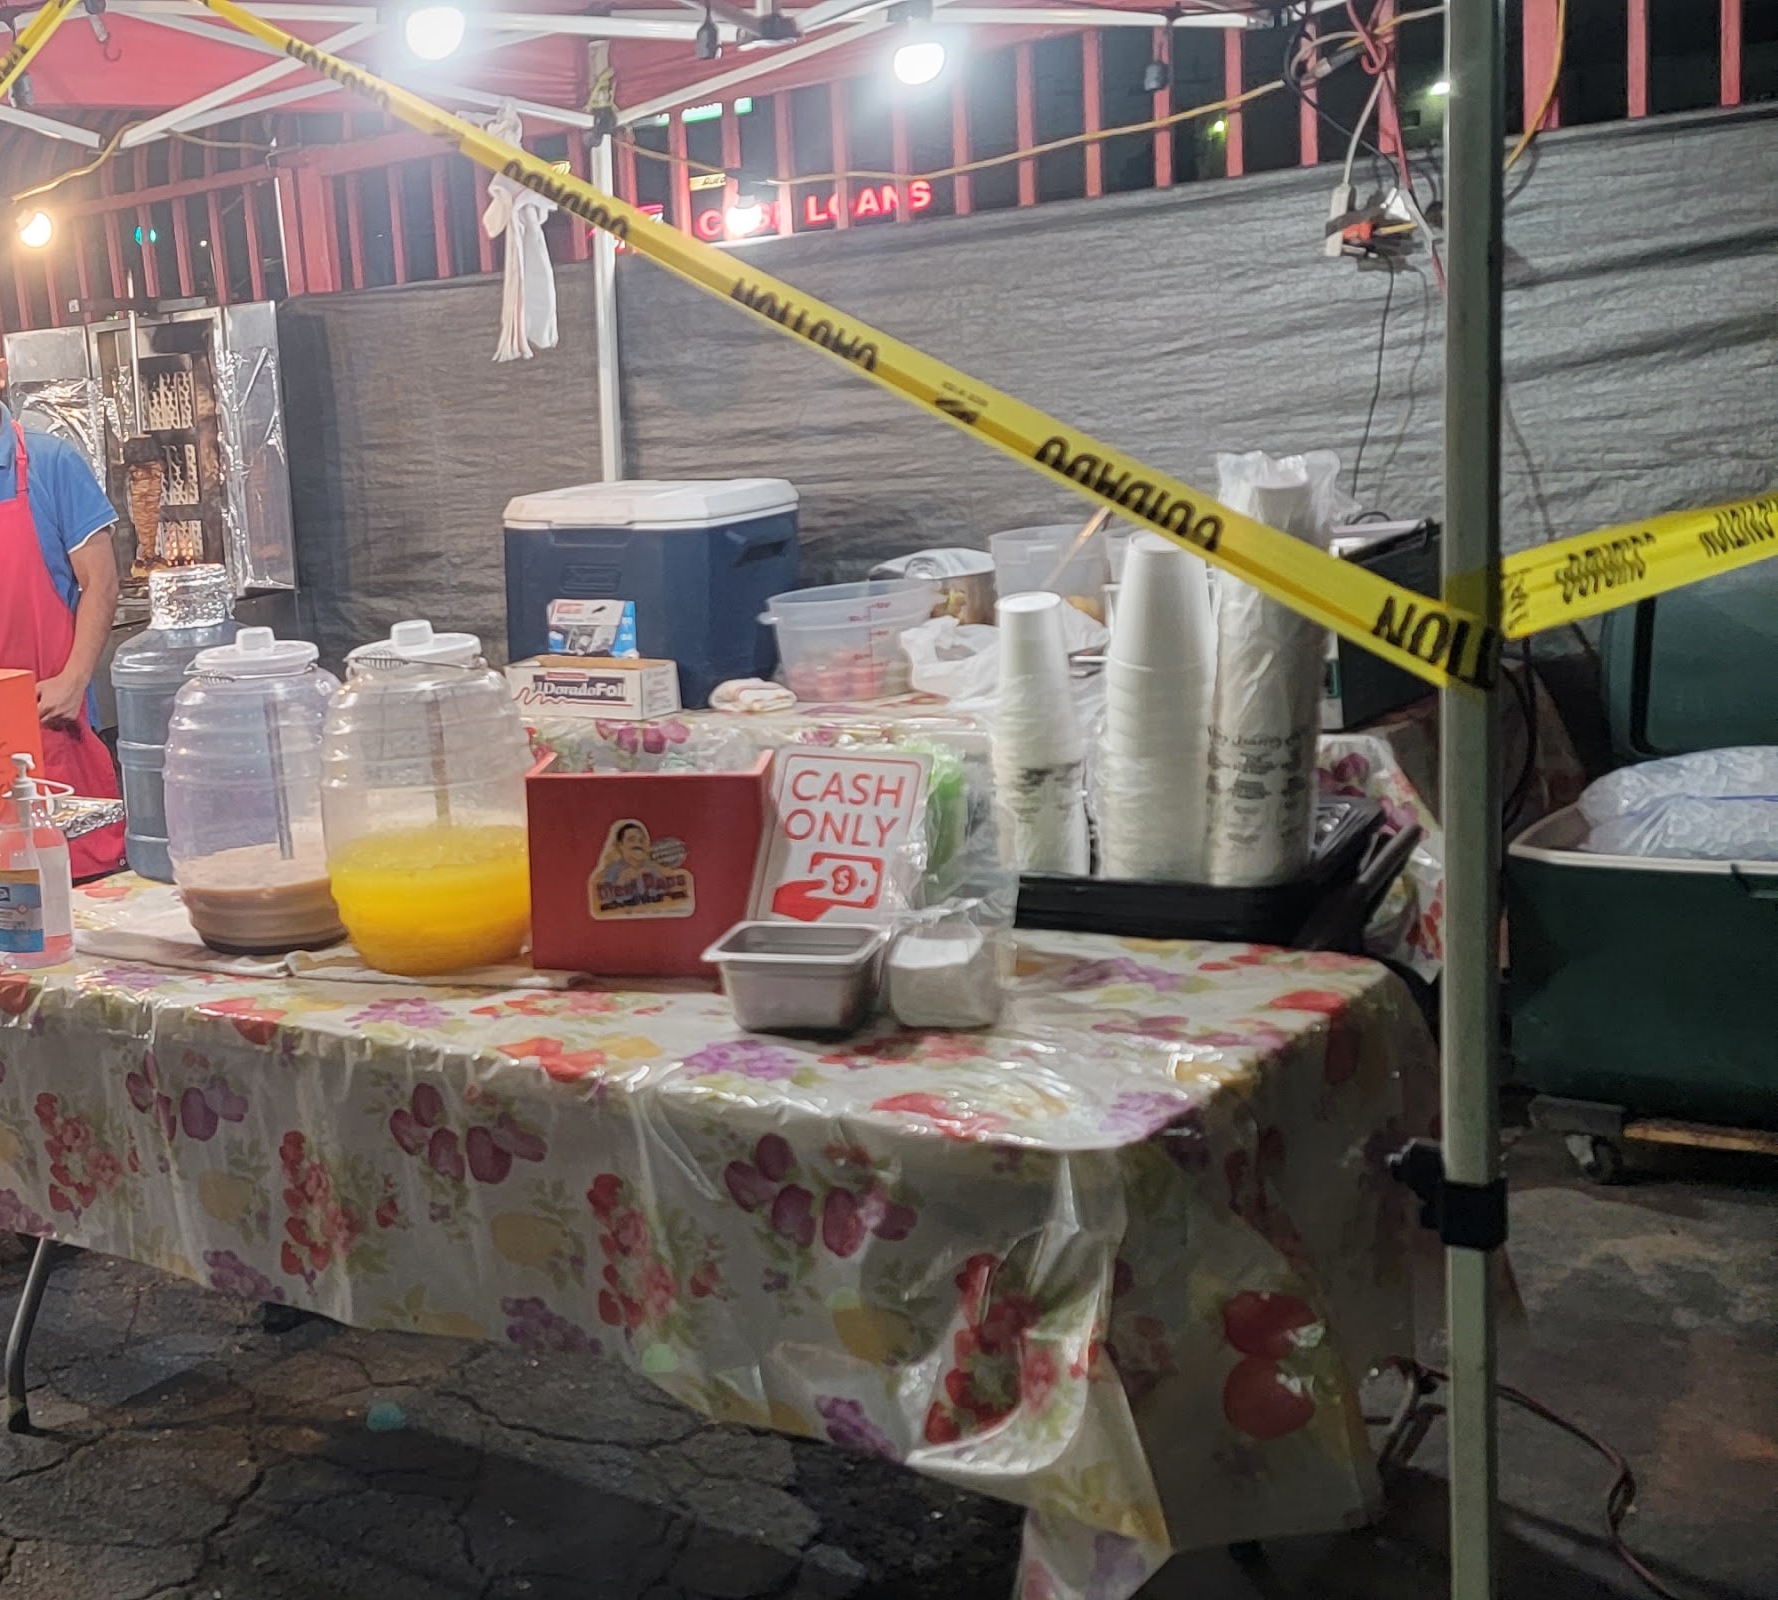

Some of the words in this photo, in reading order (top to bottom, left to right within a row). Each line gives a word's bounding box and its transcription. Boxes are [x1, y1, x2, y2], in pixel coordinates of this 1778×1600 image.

[730, 277, 880, 373] CAUTION
[791, 769, 906, 809] CASH
[784, 808, 900, 848] ONLY
